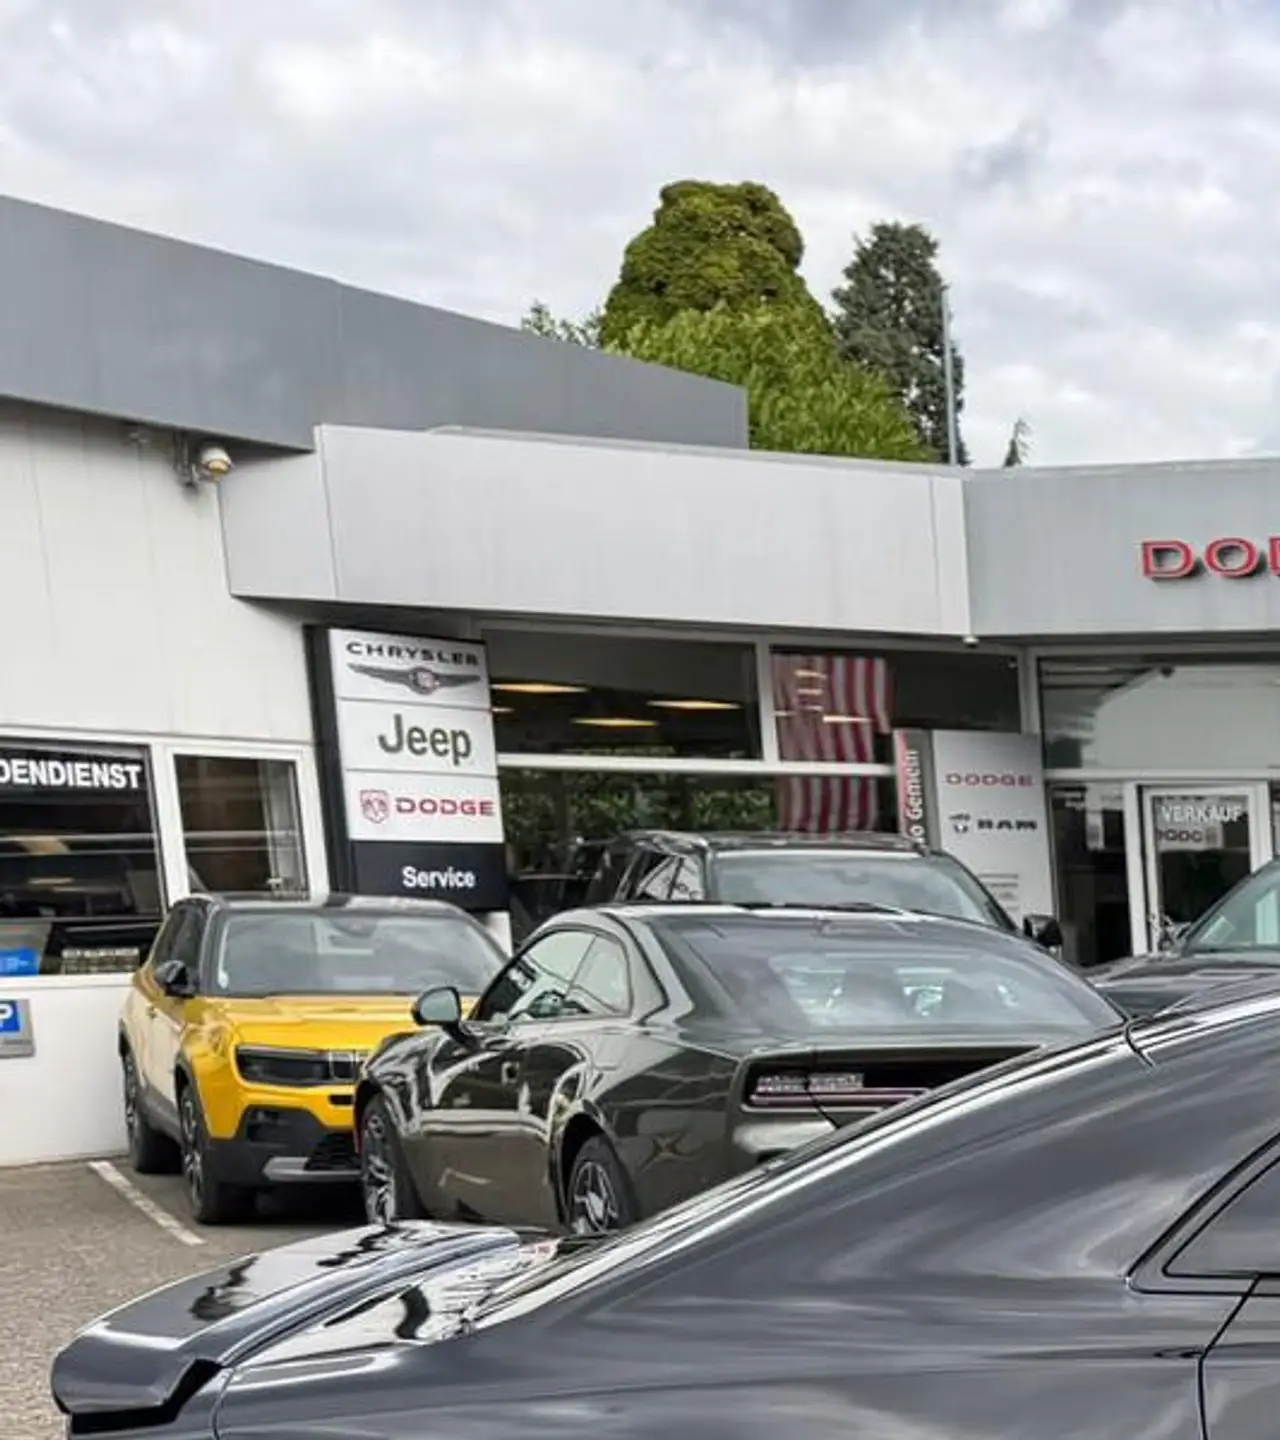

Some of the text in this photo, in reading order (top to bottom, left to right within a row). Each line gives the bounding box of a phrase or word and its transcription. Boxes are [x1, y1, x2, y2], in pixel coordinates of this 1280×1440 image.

[346, 640, 479, 666] CHRYSLER
[377, 713, 472, 767] Jeep
[946, 772, 1034, 787] DODGE
[394, 797, 495, 816] DODGE
[1160, 804, 1243, 824] VERKAUF
[402, 865, 477, 888] Service
